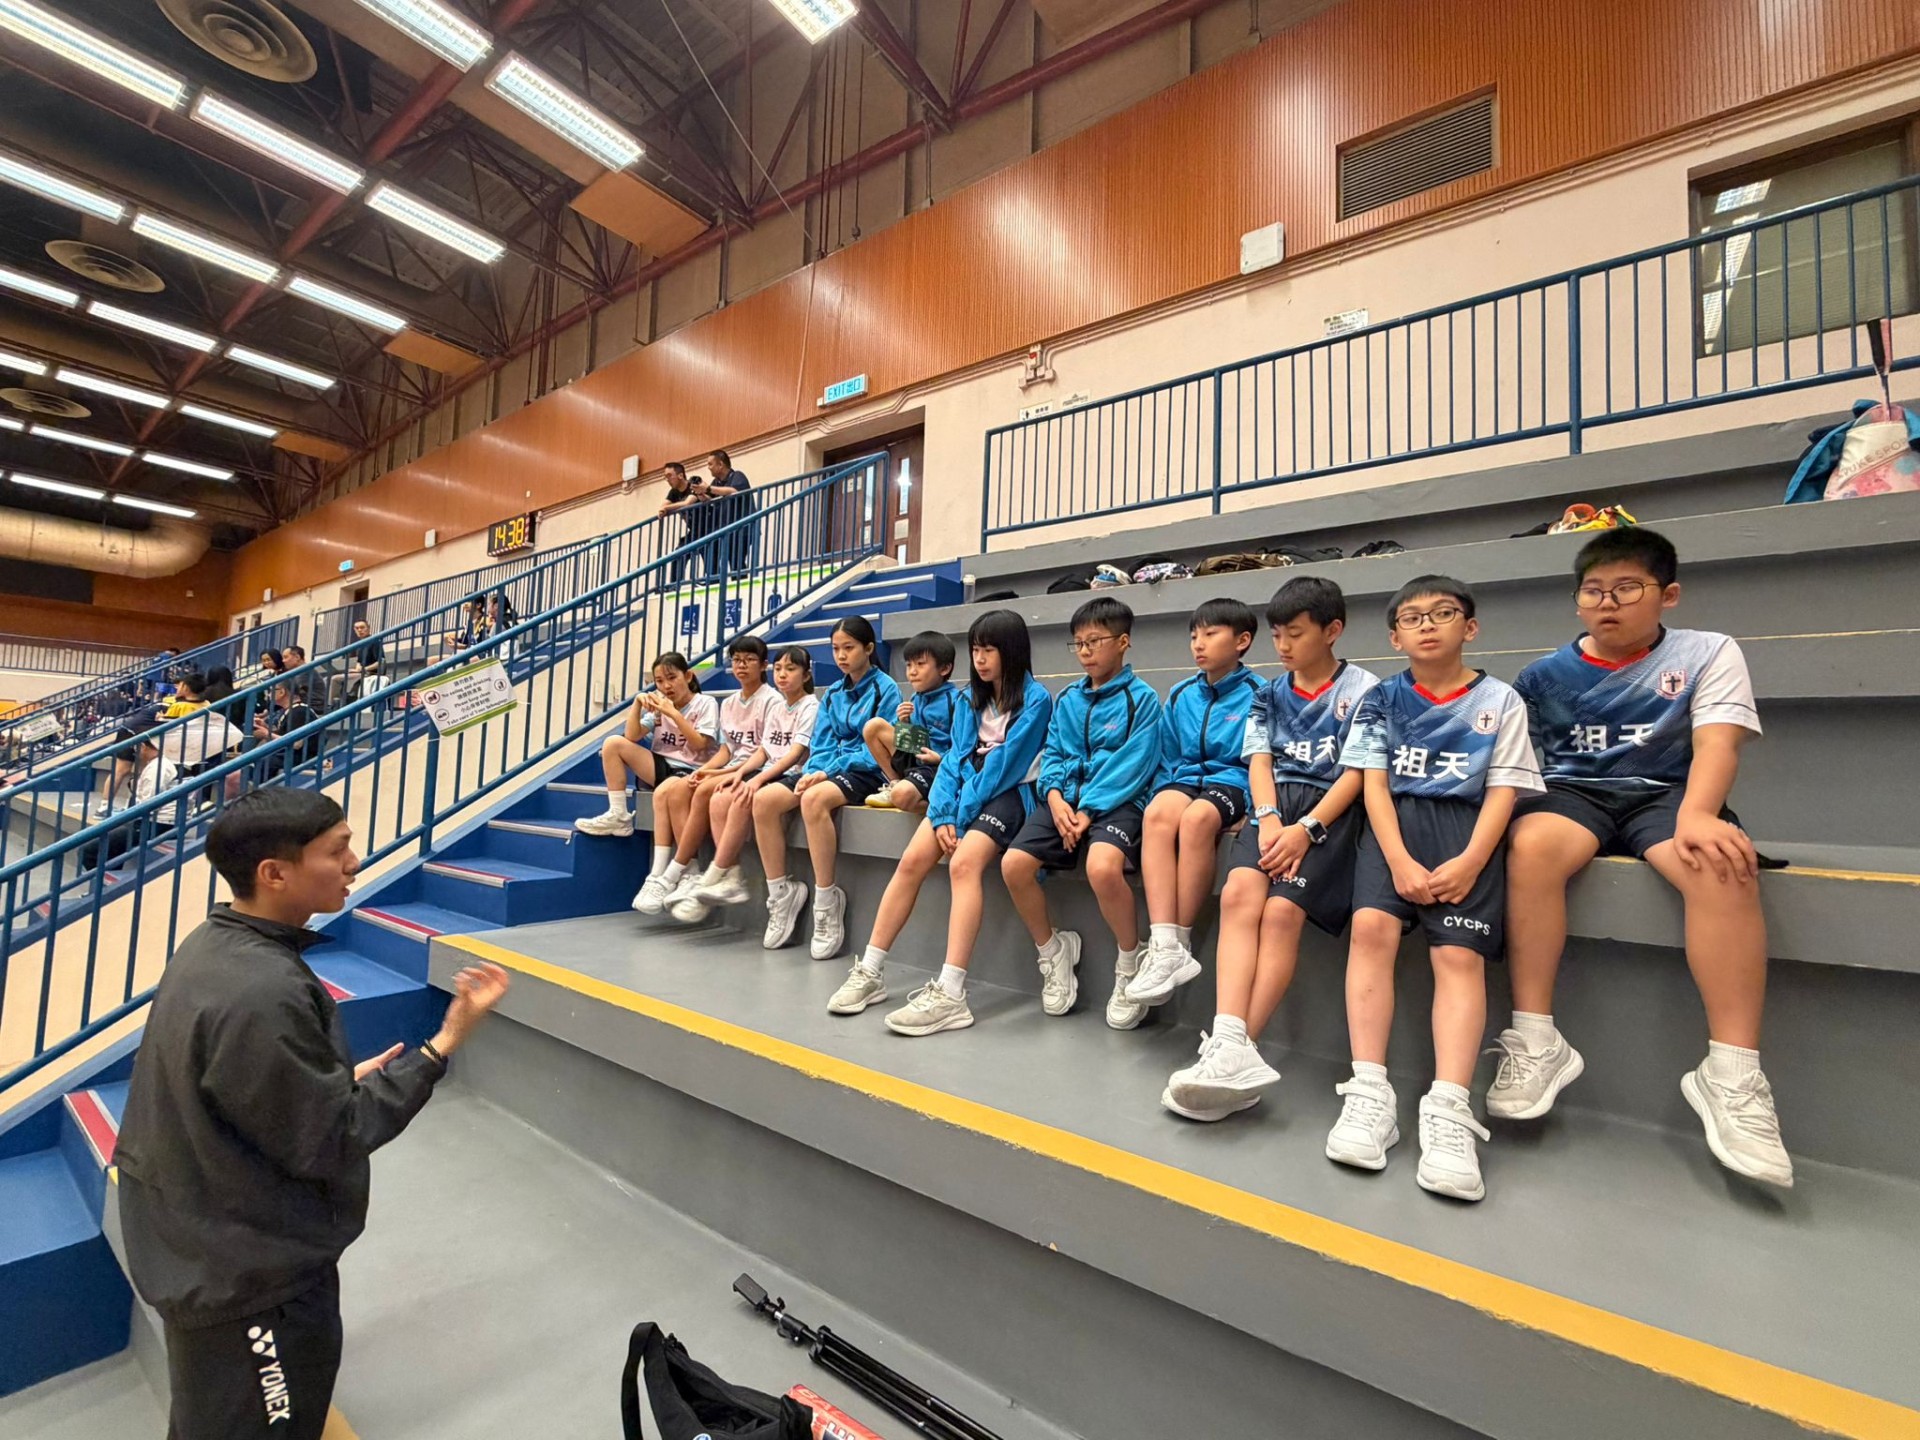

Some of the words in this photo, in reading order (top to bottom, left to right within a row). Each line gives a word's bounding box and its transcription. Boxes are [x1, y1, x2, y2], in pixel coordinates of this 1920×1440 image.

[828, 383, 846, 400] EXIT
[847, 378, 860, 393] 出口
[450, 688, 464, 696] eating
[474, 677, 491, 687] drinking
[454, 700, 468, 708] Please
[468, 696, 480, 704] keep
[447, 718, 459, 726] Take
[769, 730, 793, 746] 祖天
[1570, 723, 1656, 753] 祖天
[1283, 735, 1336, 764] 祖天
[1392, 744, 1470, 780] 祖天
[979, 814, 1006, 832] CYCPS
[1444, 916, 1490, 936] CYCPS
[258, 1360, 290, 1425] YONEX
